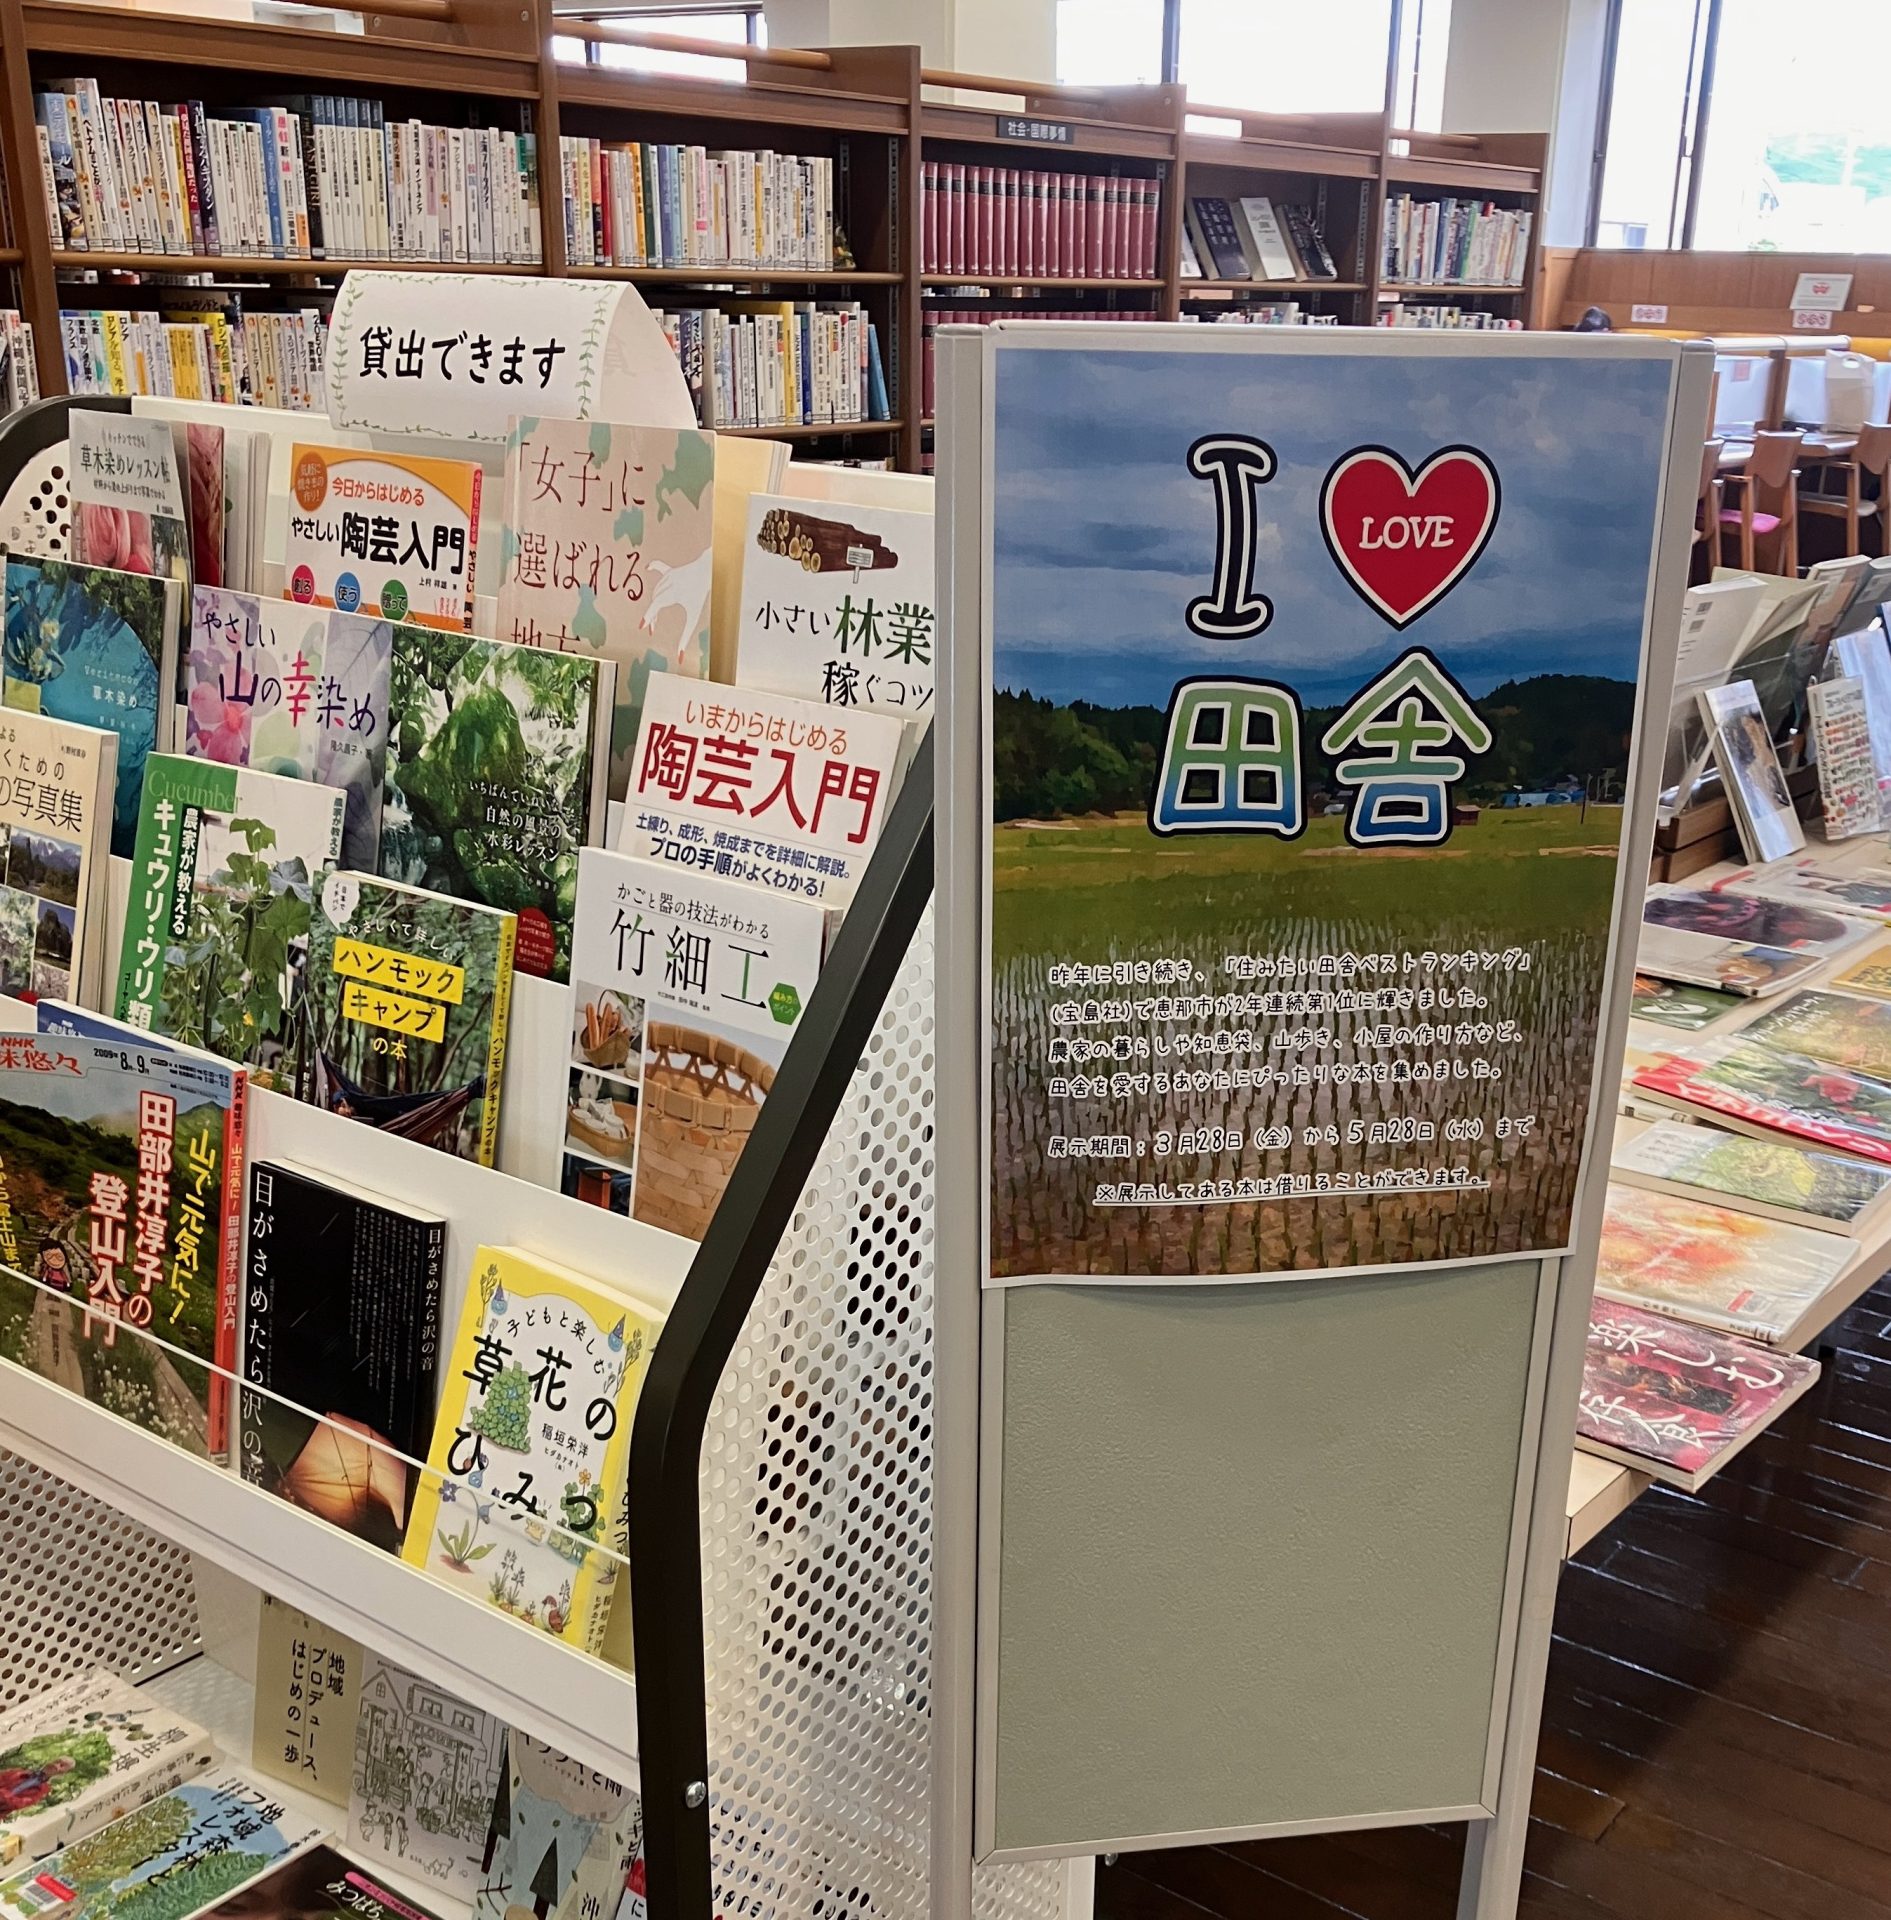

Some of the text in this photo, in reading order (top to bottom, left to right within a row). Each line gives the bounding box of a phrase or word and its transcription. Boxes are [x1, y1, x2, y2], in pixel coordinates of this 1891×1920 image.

[359, 325, 566, 390] 貸出できます
[331, 476, 425, 507] 今日からはじめる
[519, 442, 646, 512] 「女子」に
[291, 511, 466, 576] やさしい陶芸入門
[513, 531, 644, 602] 選ばれる
[1187, 433, 1455, 640] I LOVE
[337, 585, 358, 602] 使う
[201, 612, 276, 648] やさしい
[218, 650, 377, 737] 山の幸染め
[821, 660, 934, 711] 稼ぐコツ
[685, 700, 848, 756] いまからはじめる
[1147, 645, 1497, 848] 田舎
[637, 721, 881, 845] 陶芸入門
[171, 806, 200, 936] 農家が教える
[483, 830, 561, 863] 水彩レッスン
[635, 813, 851, 880] 土練り、成形、焼成までを詳細に解説。
[616, 882, 770, 939] かごと器の技法がわかる
[338, 949, 456, 996] ハンモック
[609, 907, 769, 1010] 竹細工
[0, 1036, 36, 1049] NHK
[350, 988, 438, 1034] キャンプ
[372, 1036, 409, 1062] の本
[128, 1090, 176, 1326] 田部井淳子の
[83, 1171, 130, 1347] 登山入門
[420, 1228, 442, 1371] 目がさめたら沢の音
[506, 1307, 605, 1375] 子どもと楽しむ
[540, 1422, 589, 1459] 稲垣栄洋
[284, 1638, 306, 1763] はじめの一歩
[328, 1651, 345, 1696] 地域
